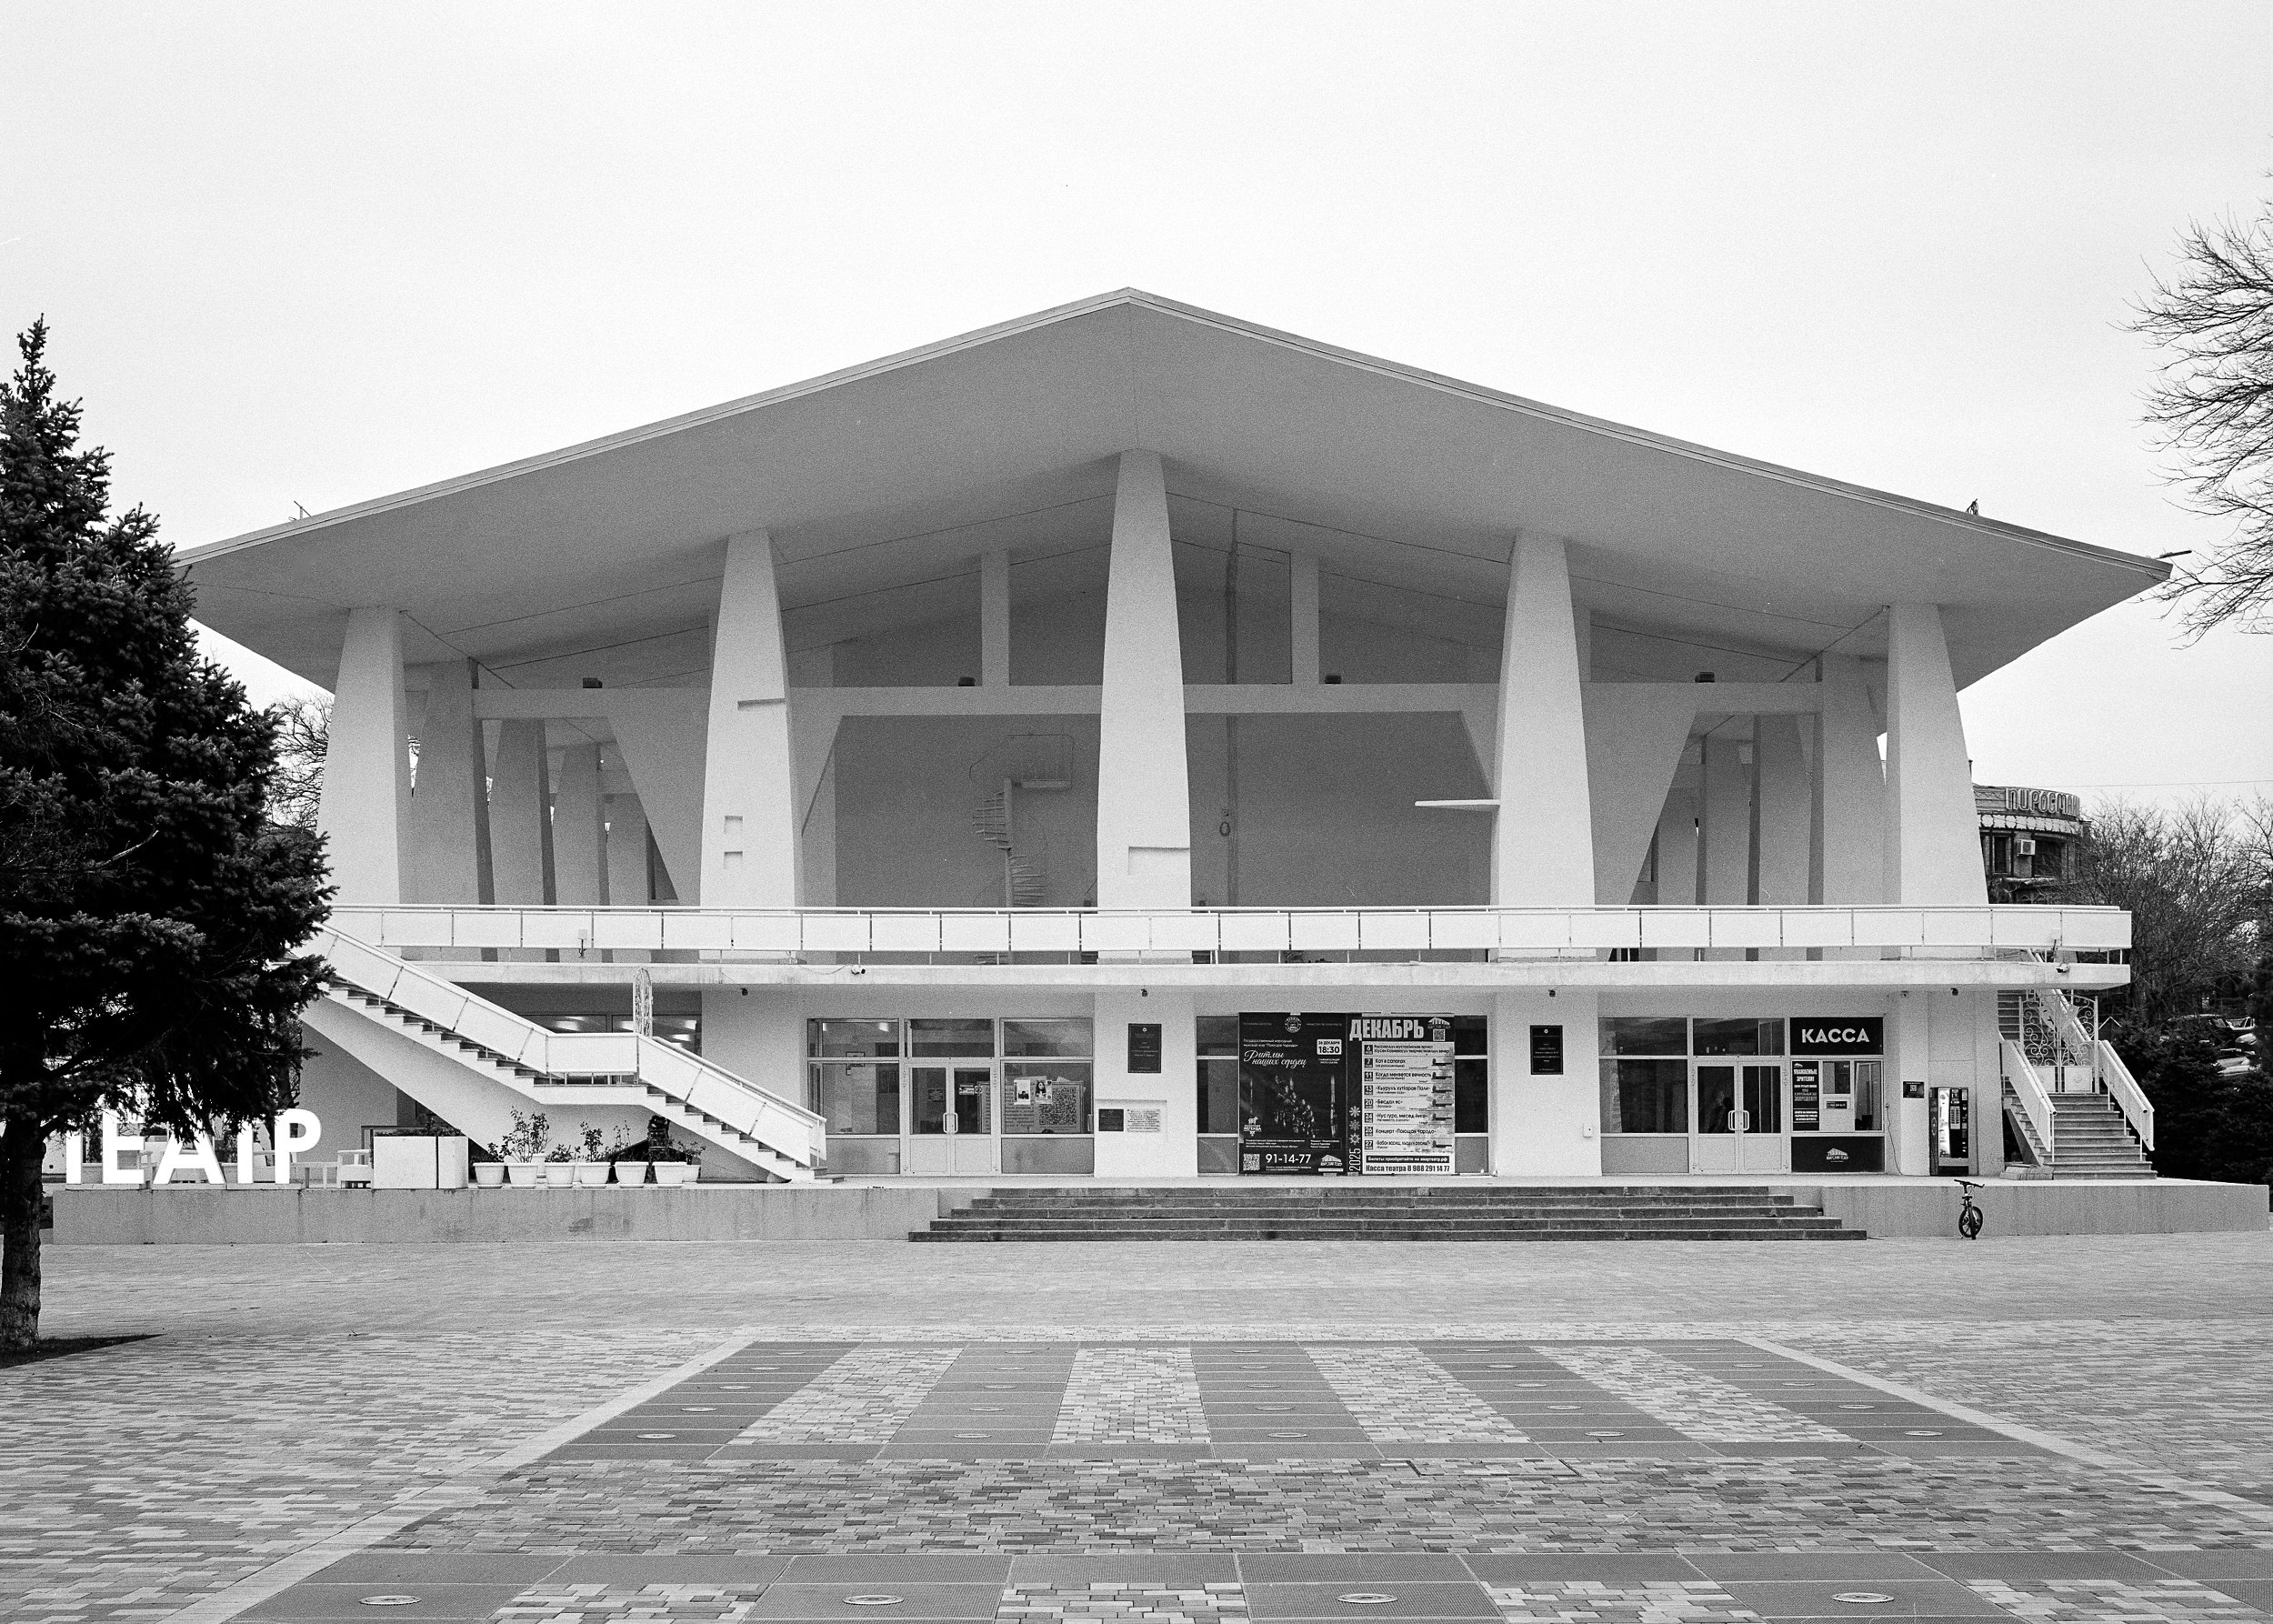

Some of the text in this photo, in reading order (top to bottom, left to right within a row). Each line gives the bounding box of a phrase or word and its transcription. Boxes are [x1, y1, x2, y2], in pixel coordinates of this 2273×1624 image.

[2005, 787, 2080, 817] ПИРОСМАН
[1349, 1018, 1425, 1041] ДЕКАБРЬ
[1801, 1028, 1870, 1043] КАССА
[1243, 1049, 1285, 1062] Ритмы
[1318, 1046, 1340, 1054] 18:30
[1251, 1058, 1307, 1068] наших сердец
[65, 1108, 322, 1185] ЕАР
[1265, 1153, 1312, 1164] 91-14-77
[1348, 1148, 1362, 1171] 2025
